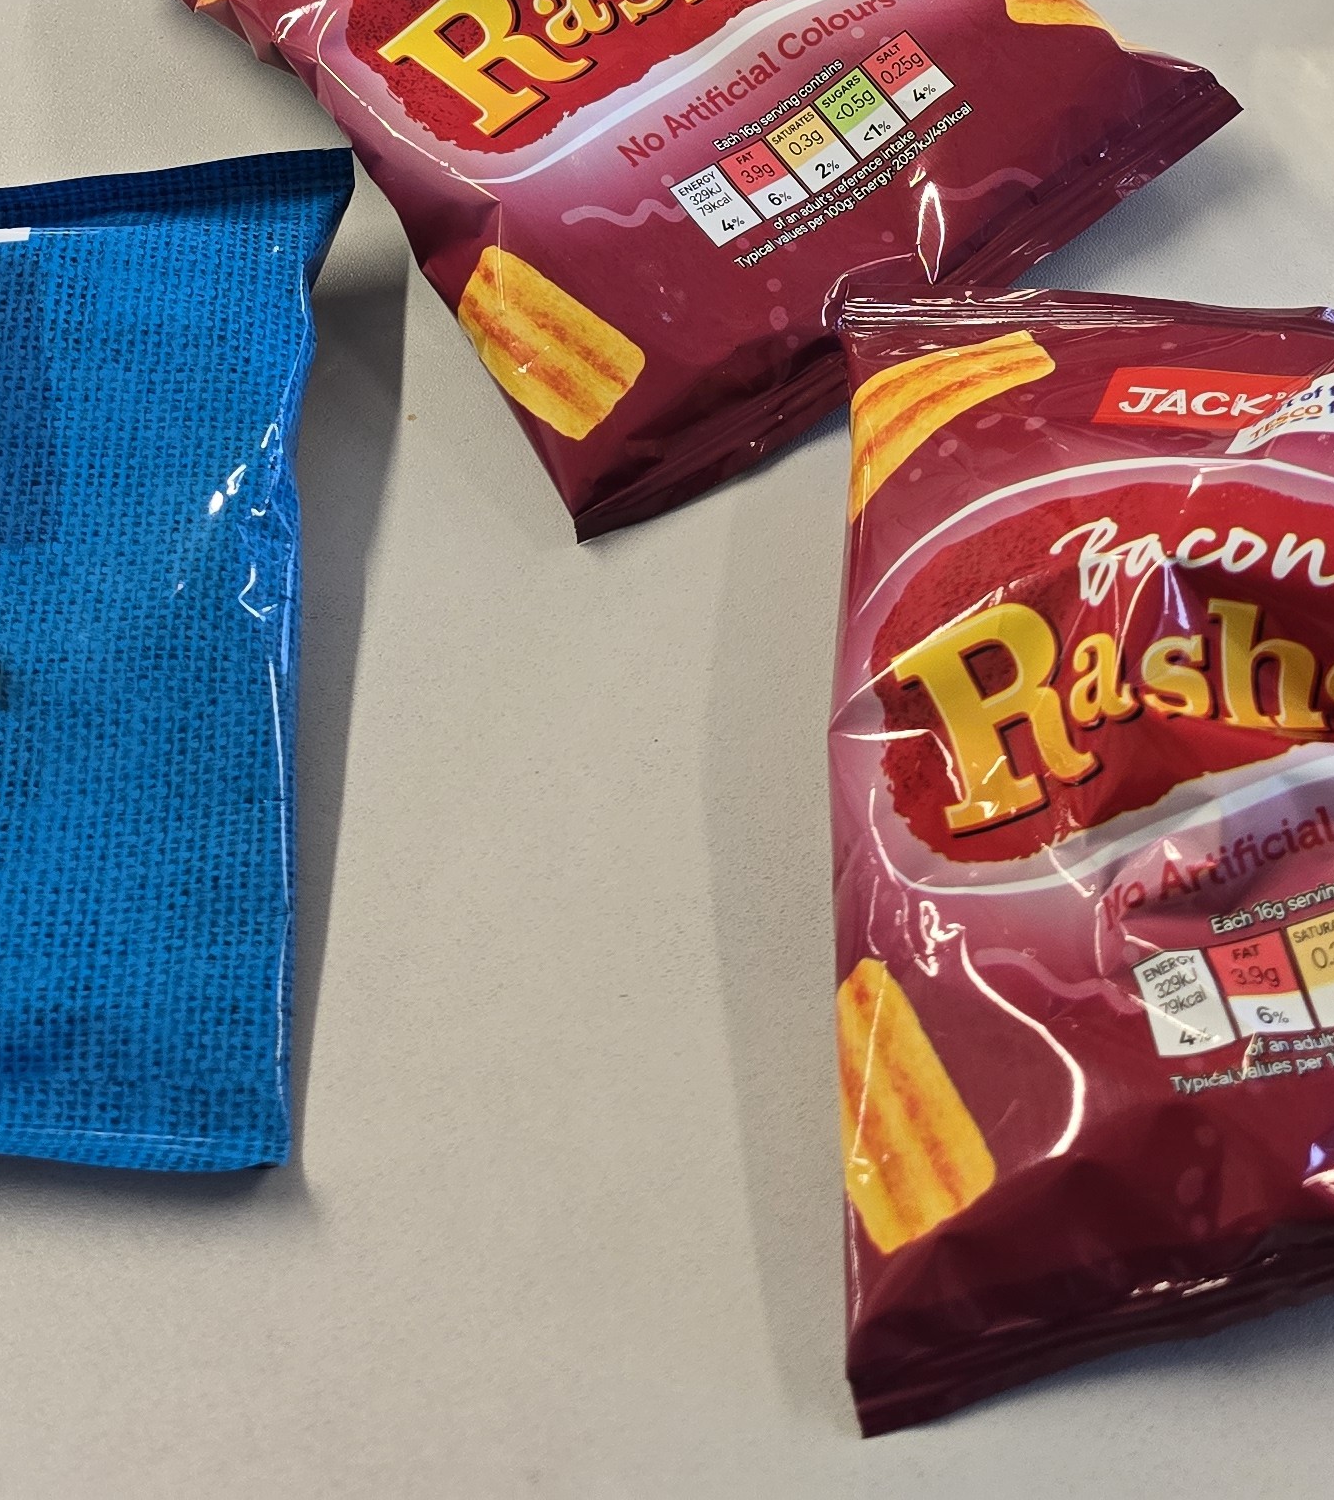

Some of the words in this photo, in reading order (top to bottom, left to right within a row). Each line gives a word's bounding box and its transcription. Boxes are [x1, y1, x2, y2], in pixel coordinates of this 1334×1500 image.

[875, 42, 901, 65] SALT
[880, 52, 925, 85] 0.25g
[821, 74, 861, 109] SUGARS
[912, 84, 936, 103] 4%
[617, 132, 665, 168] No
[662, 53, 781, 133] Artificial
[713, 128, 739, 152] Each
[738, 118, 762, 139] 16g
[760, 90, 806, 128] serving
[800, 60, 844, 100] contains
[834, 88, 876, 122] <0.5g
[771, 111, 816, 146] SATURATES
[862, 120, 891, 143] <1%
[788, 129, 824, 156] 0.3g
[736, 151, 754, 166] FAT
[815, 161, 840, 179] 2%
[678, 171, 716, 197] ENERGY
[734, 241, 774, 270] Typical
[773, 223, 809, 247] values
[806, 212, 828, 233] per
[854, 167, 895, 202] Energy:
[891, 102, 973, 171] 2057kJ/491kcal
[740, 162, 775, 184] 3.9g
[773, 217, 785, 230] of
[784, 208, 801, 224] an
[799, 190, 834, 217] adult's
[832, 157, 883, 197] reference
[881, 130, 916, 163] intake
[689, 183, 723, 206] 329kJ
[697, 192, 733, 217] 79kcal
[767, 192, 792, 206] 6%
[721, 216, 745, 232] 4%
[1300, 386, 1323, 402] of
[1250, 405, 1323, 439] TESCO
[1102, 881, 1146, 931] No
[1212, 912, 1252, 934] Each
[1254, 902, 1285, 928] 16g
[1232, 944, 1260, 961] FAT
[1142, 955, 1196, 983] ENERGY
[1154, 967, 1198, 999] 329kJ
[1256, 1005, 1290, 1024] 6%
[1247, 1037, 1263, 1056] of
[1269, 1038, 1289, 1052] an
[1170, 1070, 1231, 1095] Typical
[1238, 1058, 1292, 1080] values
[1296, 1056, 1323, 1076] per
